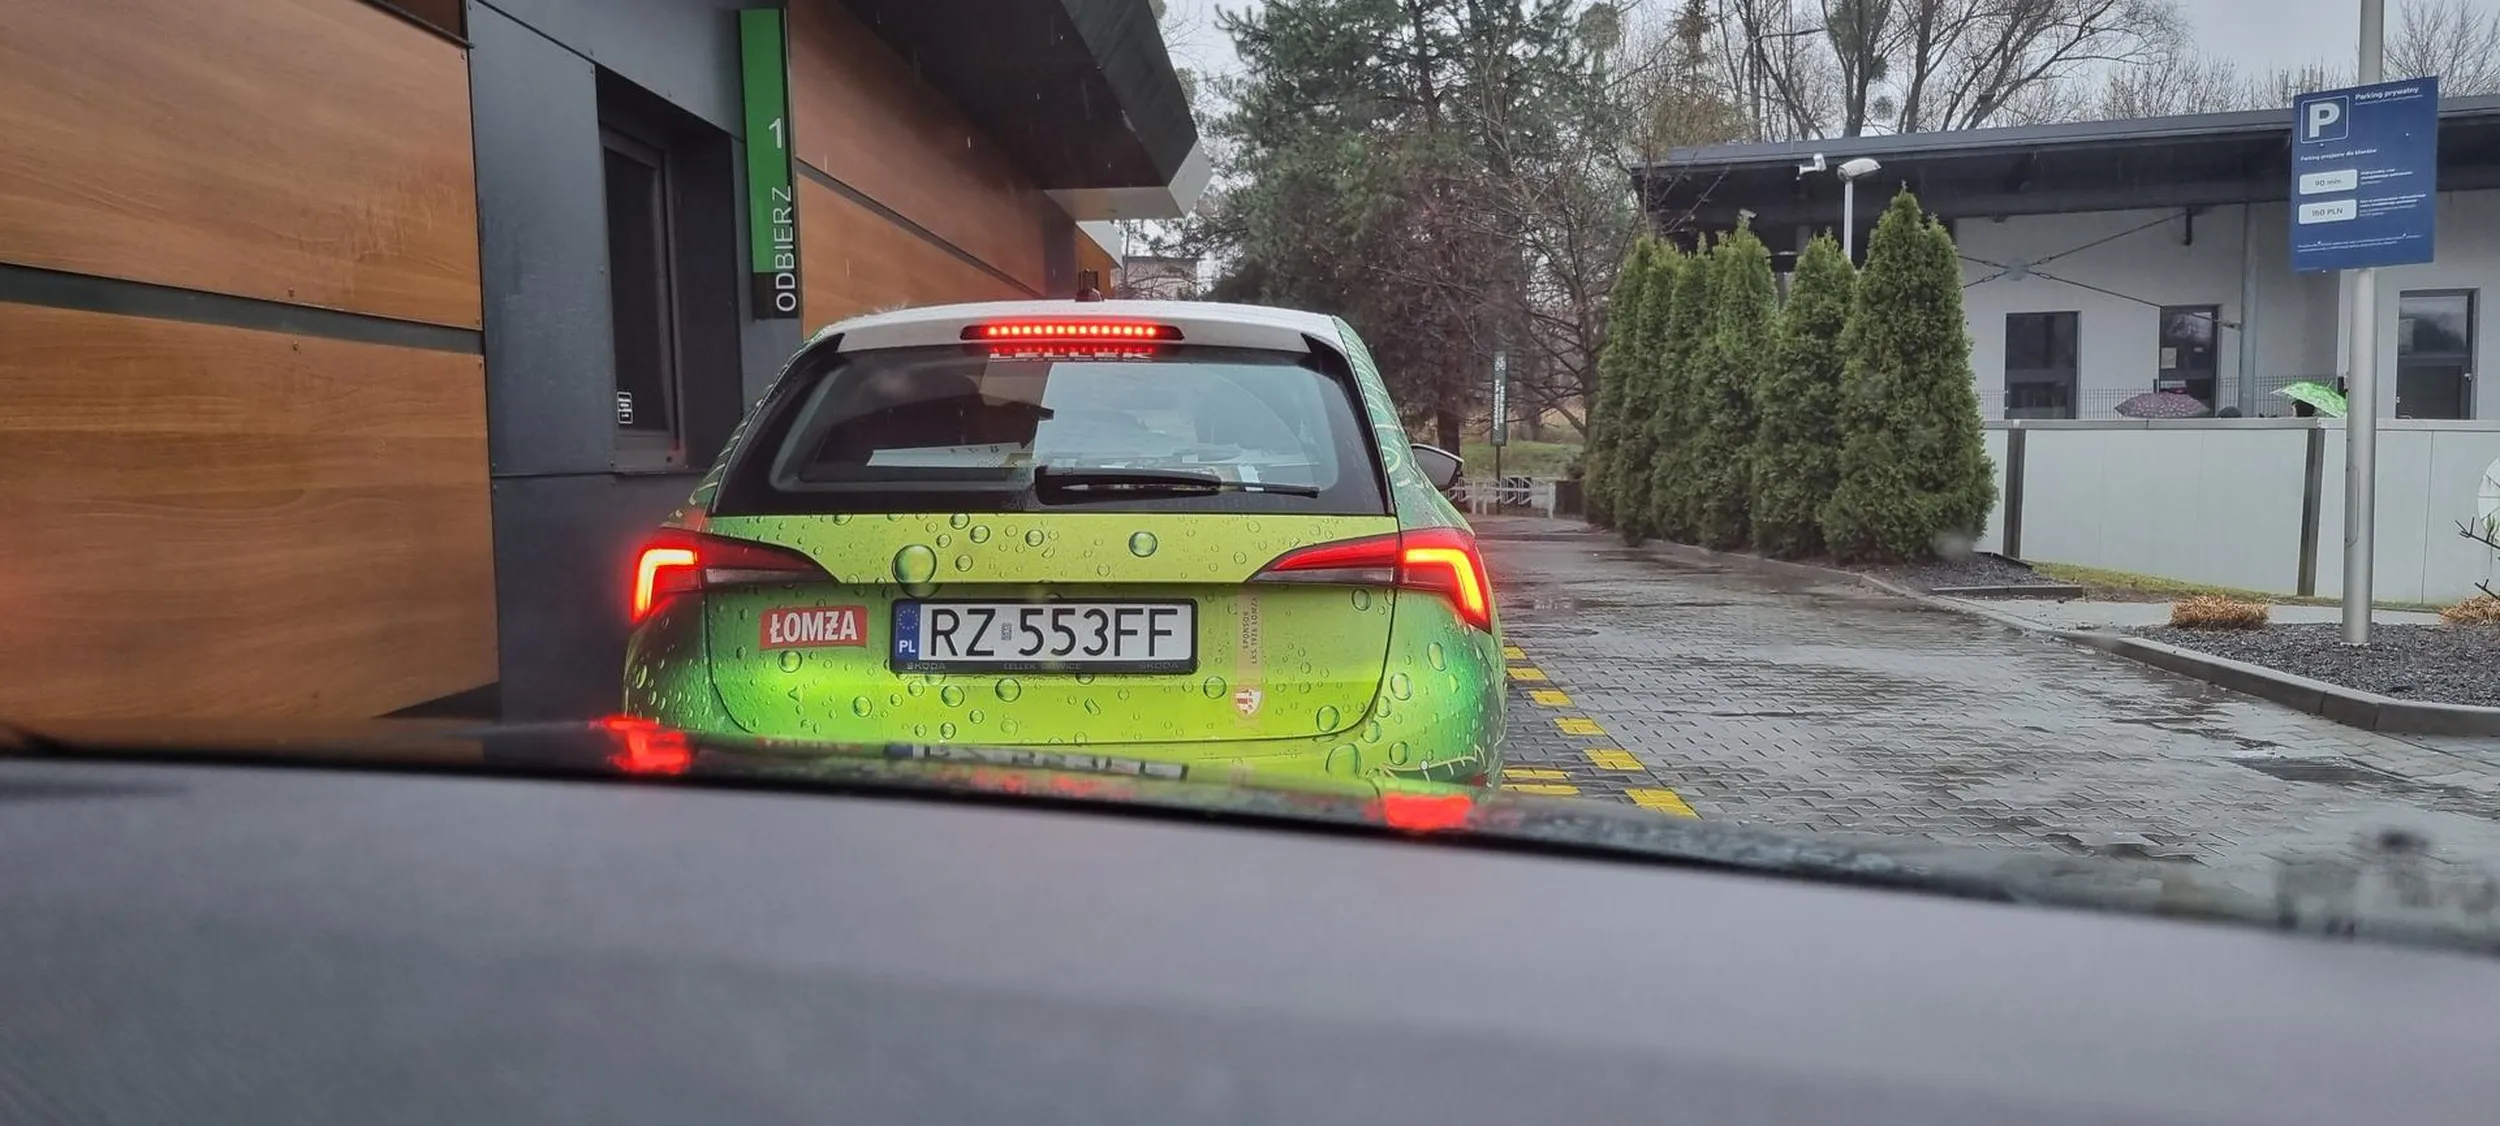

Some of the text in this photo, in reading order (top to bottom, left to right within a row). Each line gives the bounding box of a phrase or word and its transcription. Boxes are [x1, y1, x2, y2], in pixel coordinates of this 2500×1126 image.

[2355, 91, 2383, 101] Parking
[2384, 87, 2420, 98] prywatny
[768, 118, 783, 149] 1
[2309, 102, 2340, 138] P
[772, 185, 798, 313] ODBIERZ
[769, 610, 859, 644] ŁOMŻA
[930, 608, 1178, 657] RZ 553FF
[1242, 611, 1250, 649] SPONSOR
[899, 640, 916, 653] PL
